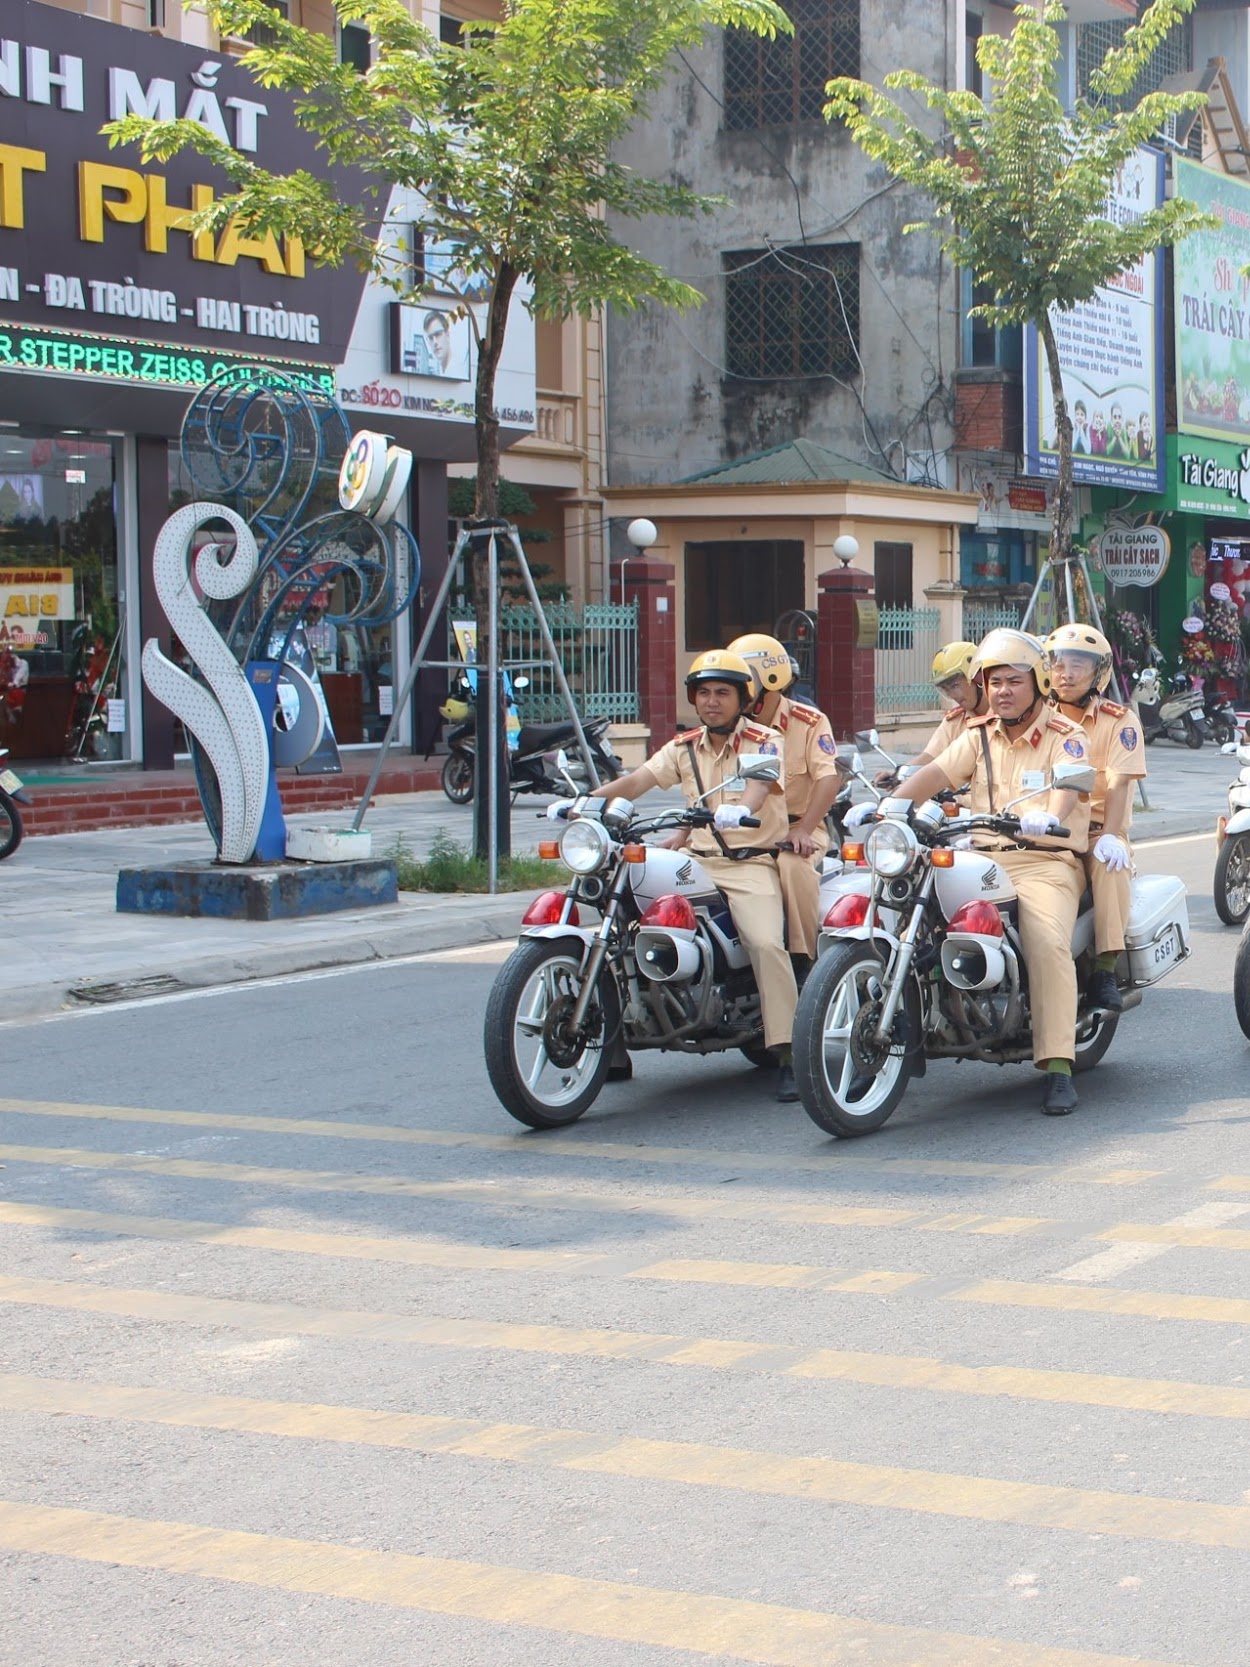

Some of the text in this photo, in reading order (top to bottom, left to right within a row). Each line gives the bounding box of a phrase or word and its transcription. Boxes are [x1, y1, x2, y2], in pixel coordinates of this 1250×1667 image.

[109, 61, 268, 152] MẮT
[45, 273, 85, 311] ĐA
[89, 276, 177, 323] TRÒNG
[197, 297, 241, 333] HAI
[243, 301, 320, 344] TRÒNG
[1183, 292, 1215, 333] TRÁI
[1219, 301, 1245, 340] CÂY
[1181, 455, 1201, 485] Tài
[1203, 459, 1238, 498] Giang
[1105, 545, 1122, 565] TRÁI
[1140, 548, 1160, 568] SẠCH
[1109, 532, 1157, 544] TÀI GIANG
[1154, 937, 1174, 963] CSGT
